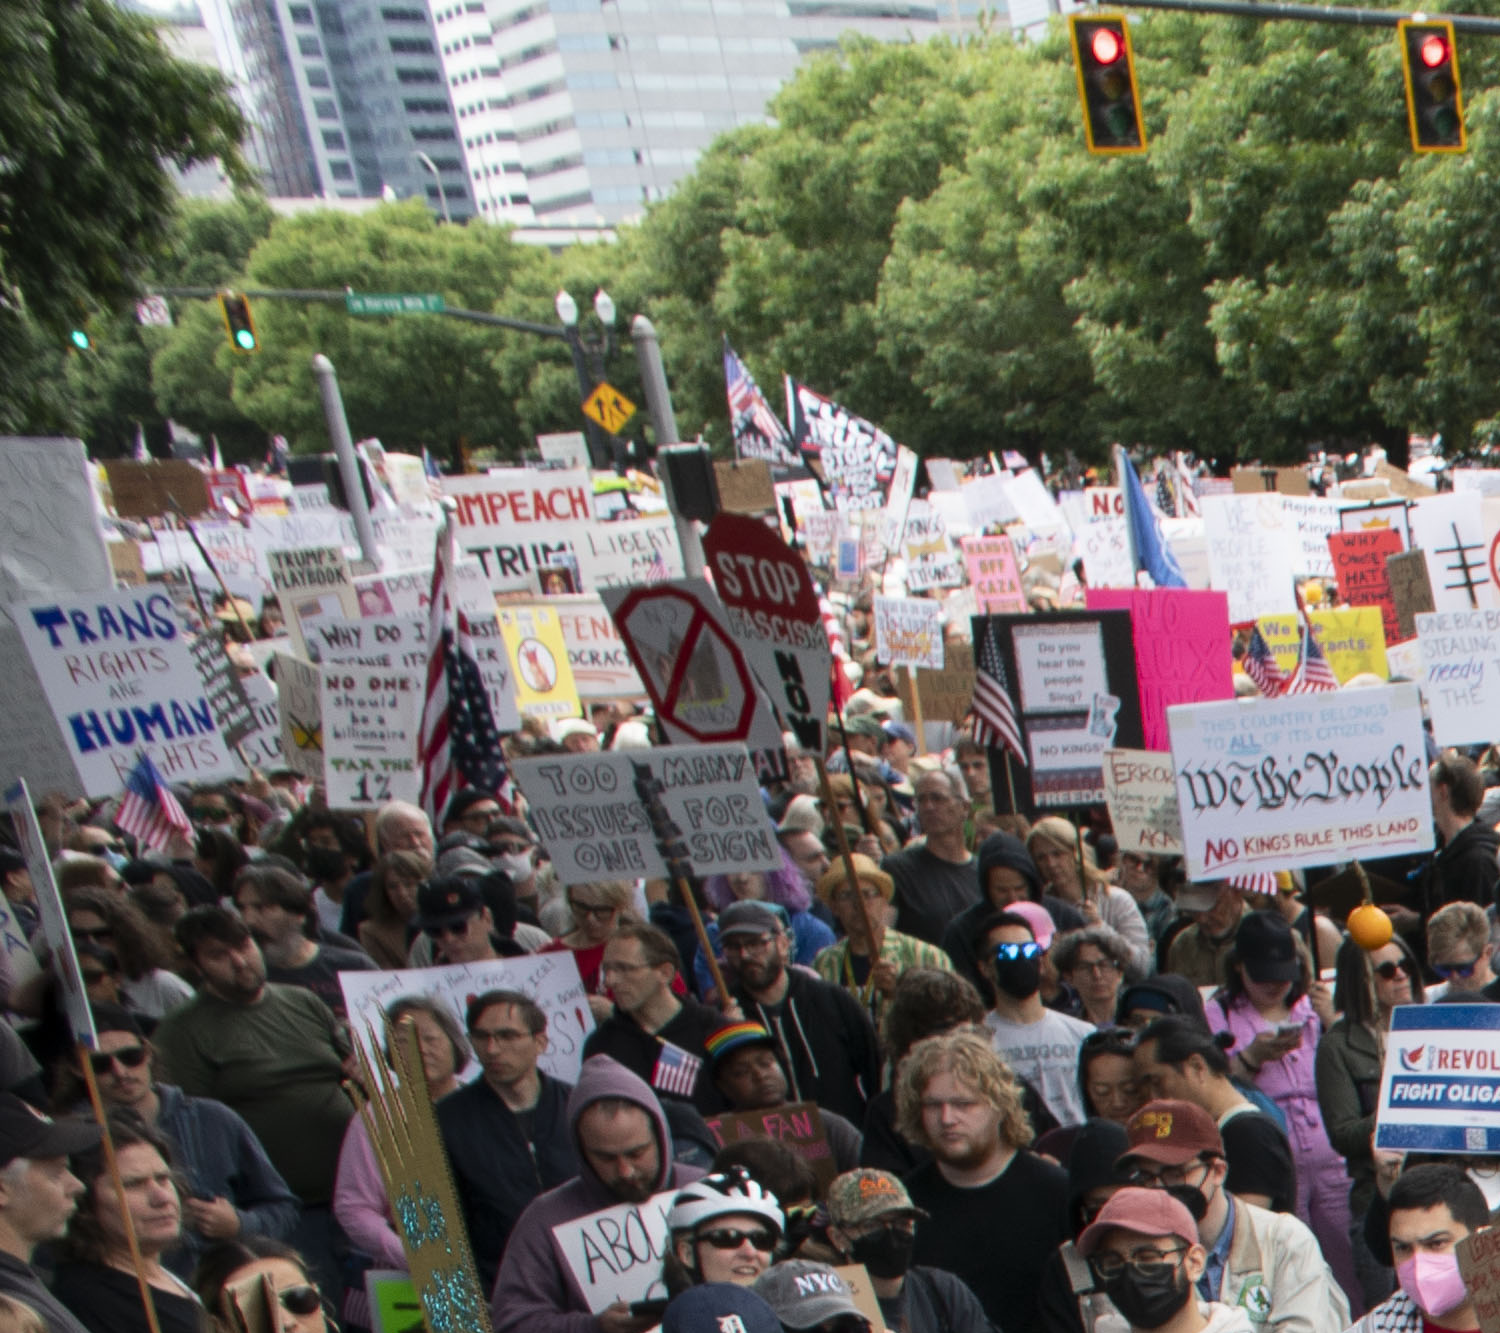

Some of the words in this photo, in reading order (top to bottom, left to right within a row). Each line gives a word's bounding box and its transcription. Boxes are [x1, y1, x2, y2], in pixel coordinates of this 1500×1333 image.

[454, 487, 590, 527] IMPEACH
[274, 567, 347, 588] PLAYBOOK
[717, 553, 800, 604] STOP
[31, 593, 176, 648] TRANS
[727, 607, 828, 650] FASCISM
[65, 648, 170, 686] RIGHTS
[327, 677, 354, 691] NO
[109, 683, 143, 698] ARE
[334, 696, 398, 709] should
[68, 699, 215, 752] HUMAN
[1204, 716, 1237, 733] THIS
[1241, 711, 1312, 730] COUNTRY
[1317, 704, 1389, 723] BELONGS
[1205, 736, 1224, 751] TO
[1229, 734, 1260, 750] ALL
[1265, 732, 1282, 746] OF
[1316, 722, 1384, 740] CITIZENS
[331, 759, 373, 772] TAX
[539, 766, 617, 795] TOO
[662, 755, 747, 788] MANY
[1305, 744, 1423, 810] People
[534, 807, 651, 842] ISSUES
[684, 793, 757, 825] FOR
[573, 844, 646, 874] ONE
[691, 830, 772, 864] SIGN
[1206, 840, 1238, 866] NO
[1245, 834, 1290, 855] KINGS
[1295, 830, 1332, 847] RULE
[1342, 826, 1372, 840] THIS
[1377, 819, 1418, 834] LAND
[1394, 1082, 1444, 1102] FIGHT
[794, 1274, 843, 1296] NYC
